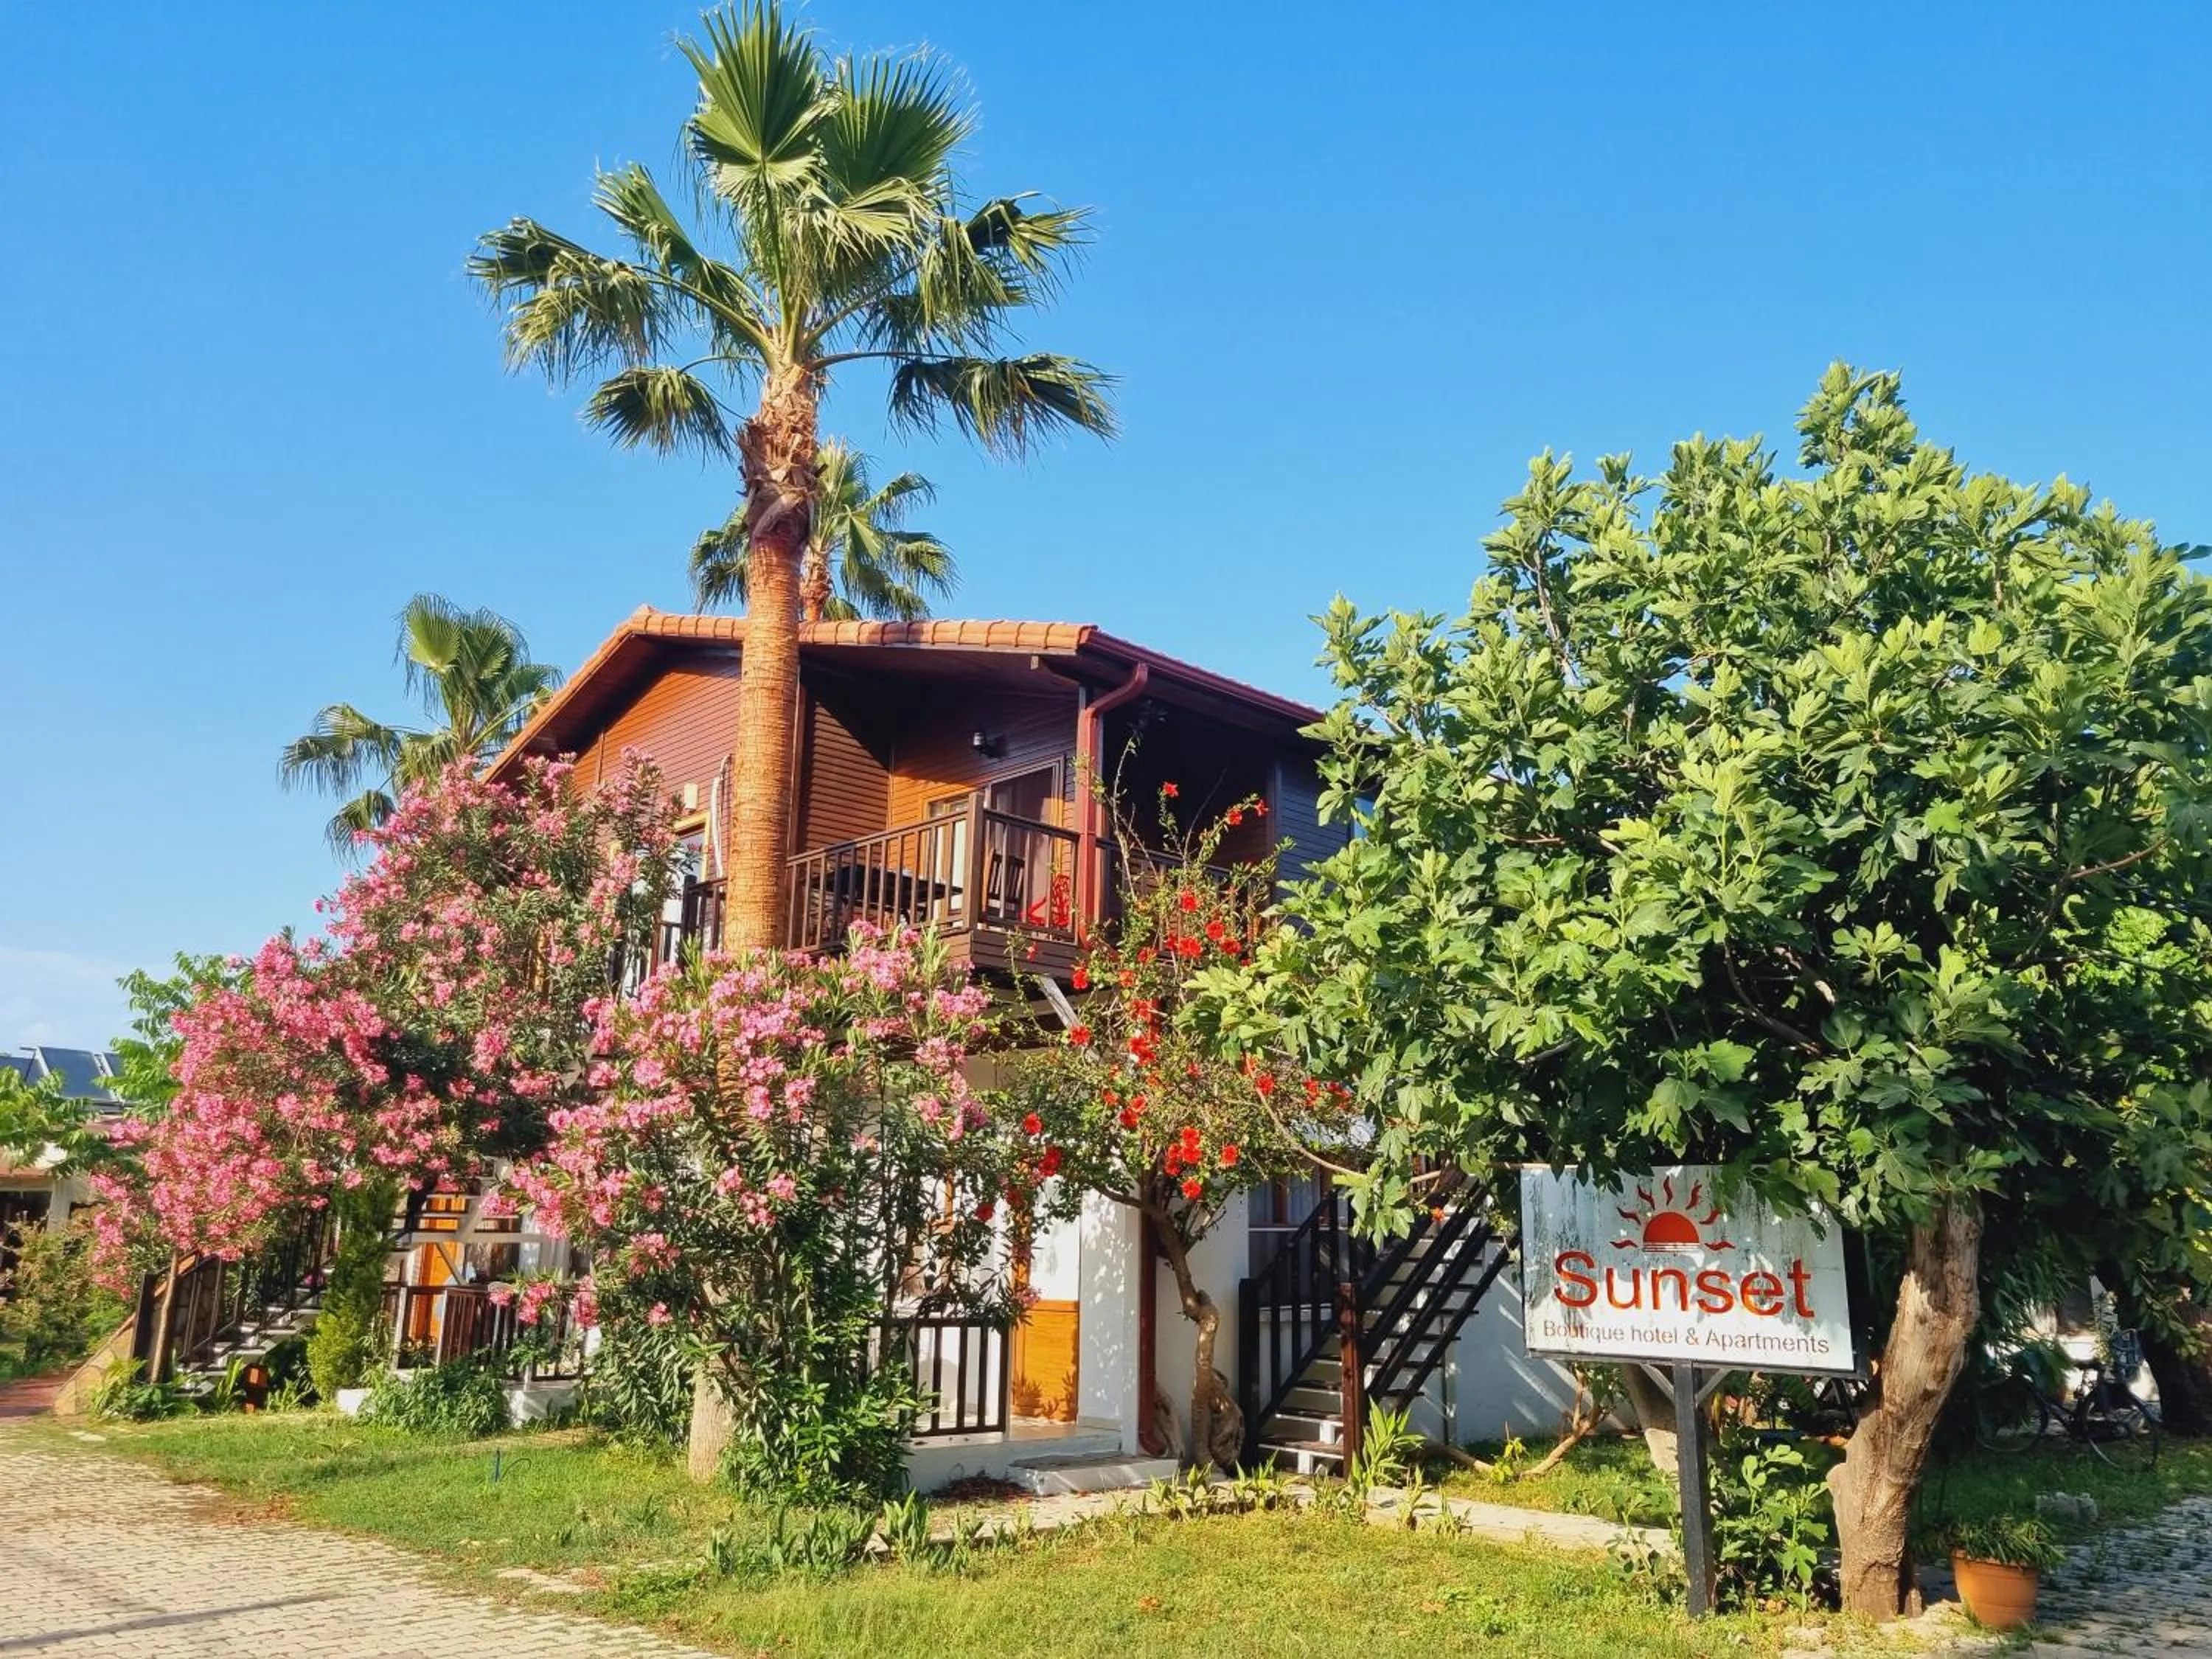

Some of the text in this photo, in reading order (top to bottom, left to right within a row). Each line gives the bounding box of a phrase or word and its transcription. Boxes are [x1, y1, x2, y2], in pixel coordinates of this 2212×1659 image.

[1554, 1251, 1815, 1318] Sunset
[1543, 1320, 1830, 1354] Boutique hotel & Apartments
